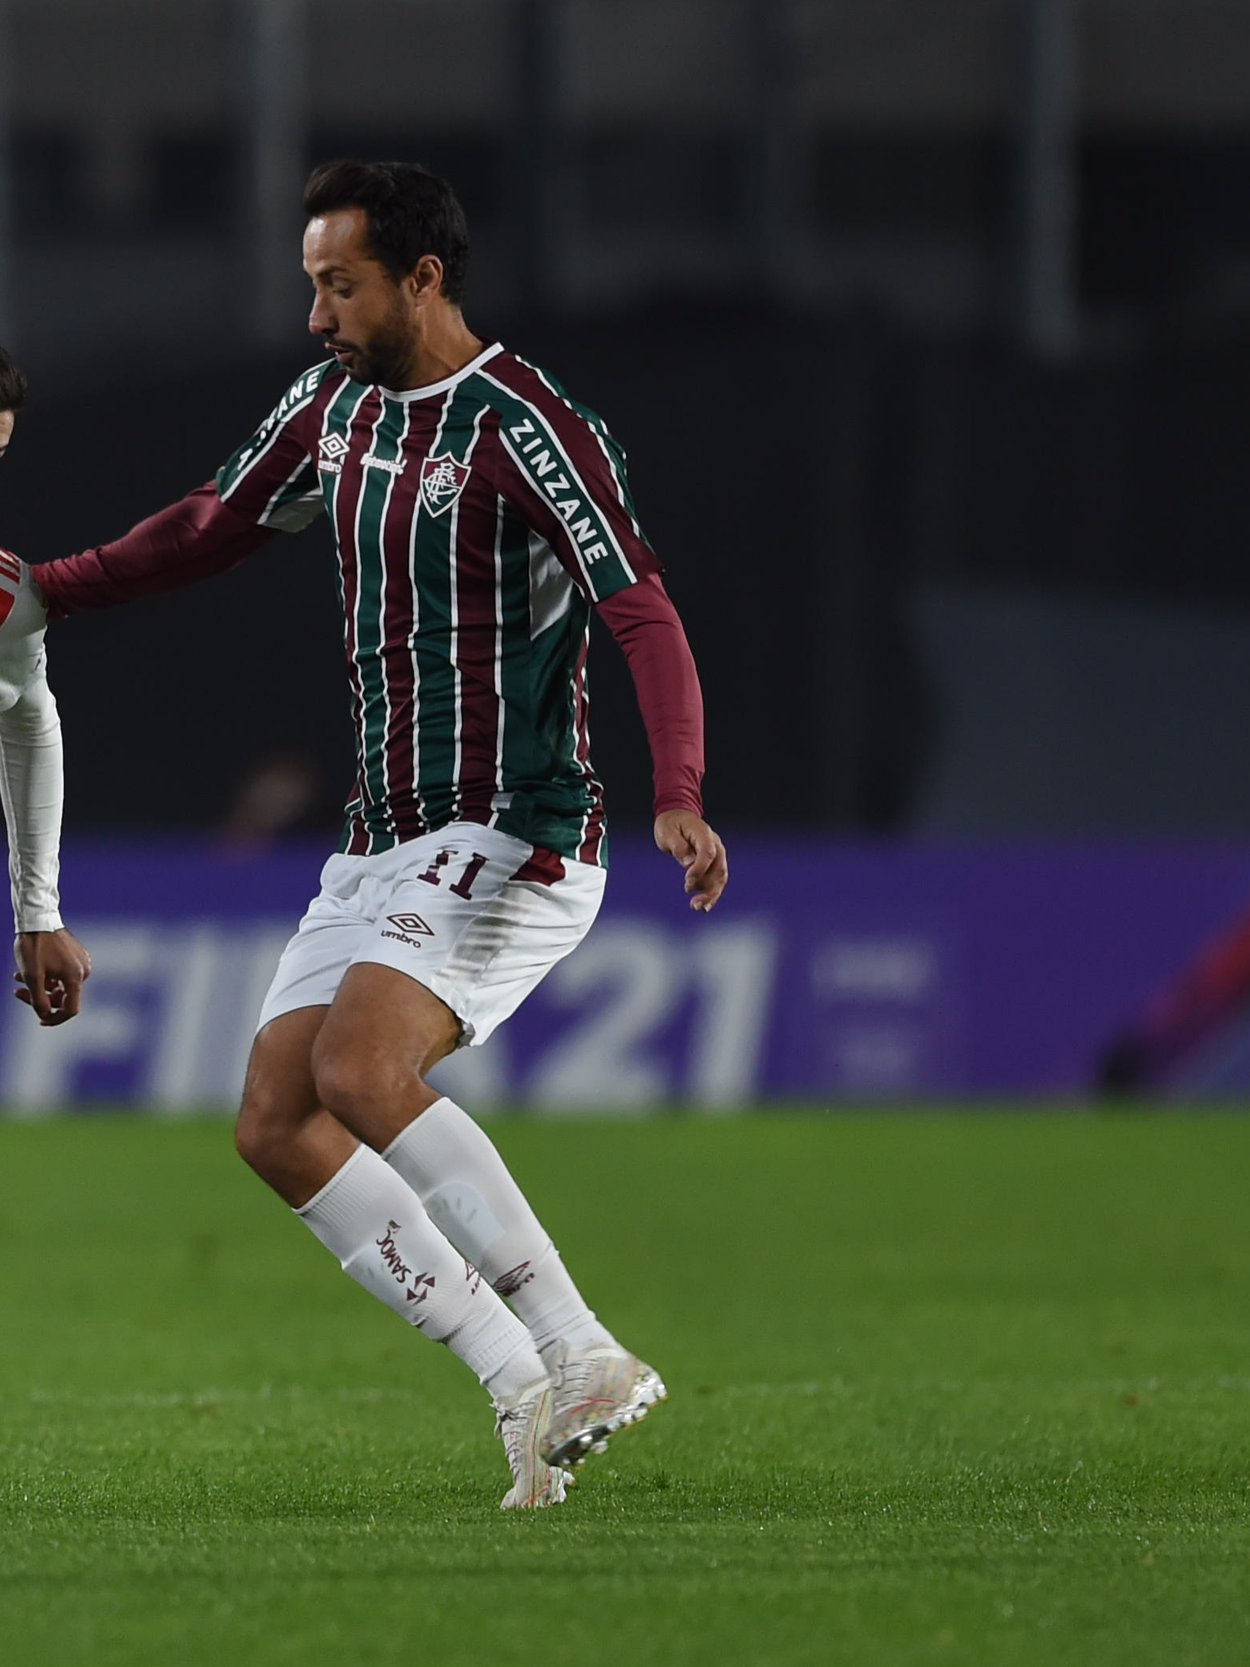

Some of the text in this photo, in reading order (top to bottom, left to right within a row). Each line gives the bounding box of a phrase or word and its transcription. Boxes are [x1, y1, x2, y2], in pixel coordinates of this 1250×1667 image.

[509, 418, 609, 565] ZINZANE
[416, 849, 491, 901] 11
[380, 929, 422, 949] umbro
[535, 912, 778, 1112] 21
